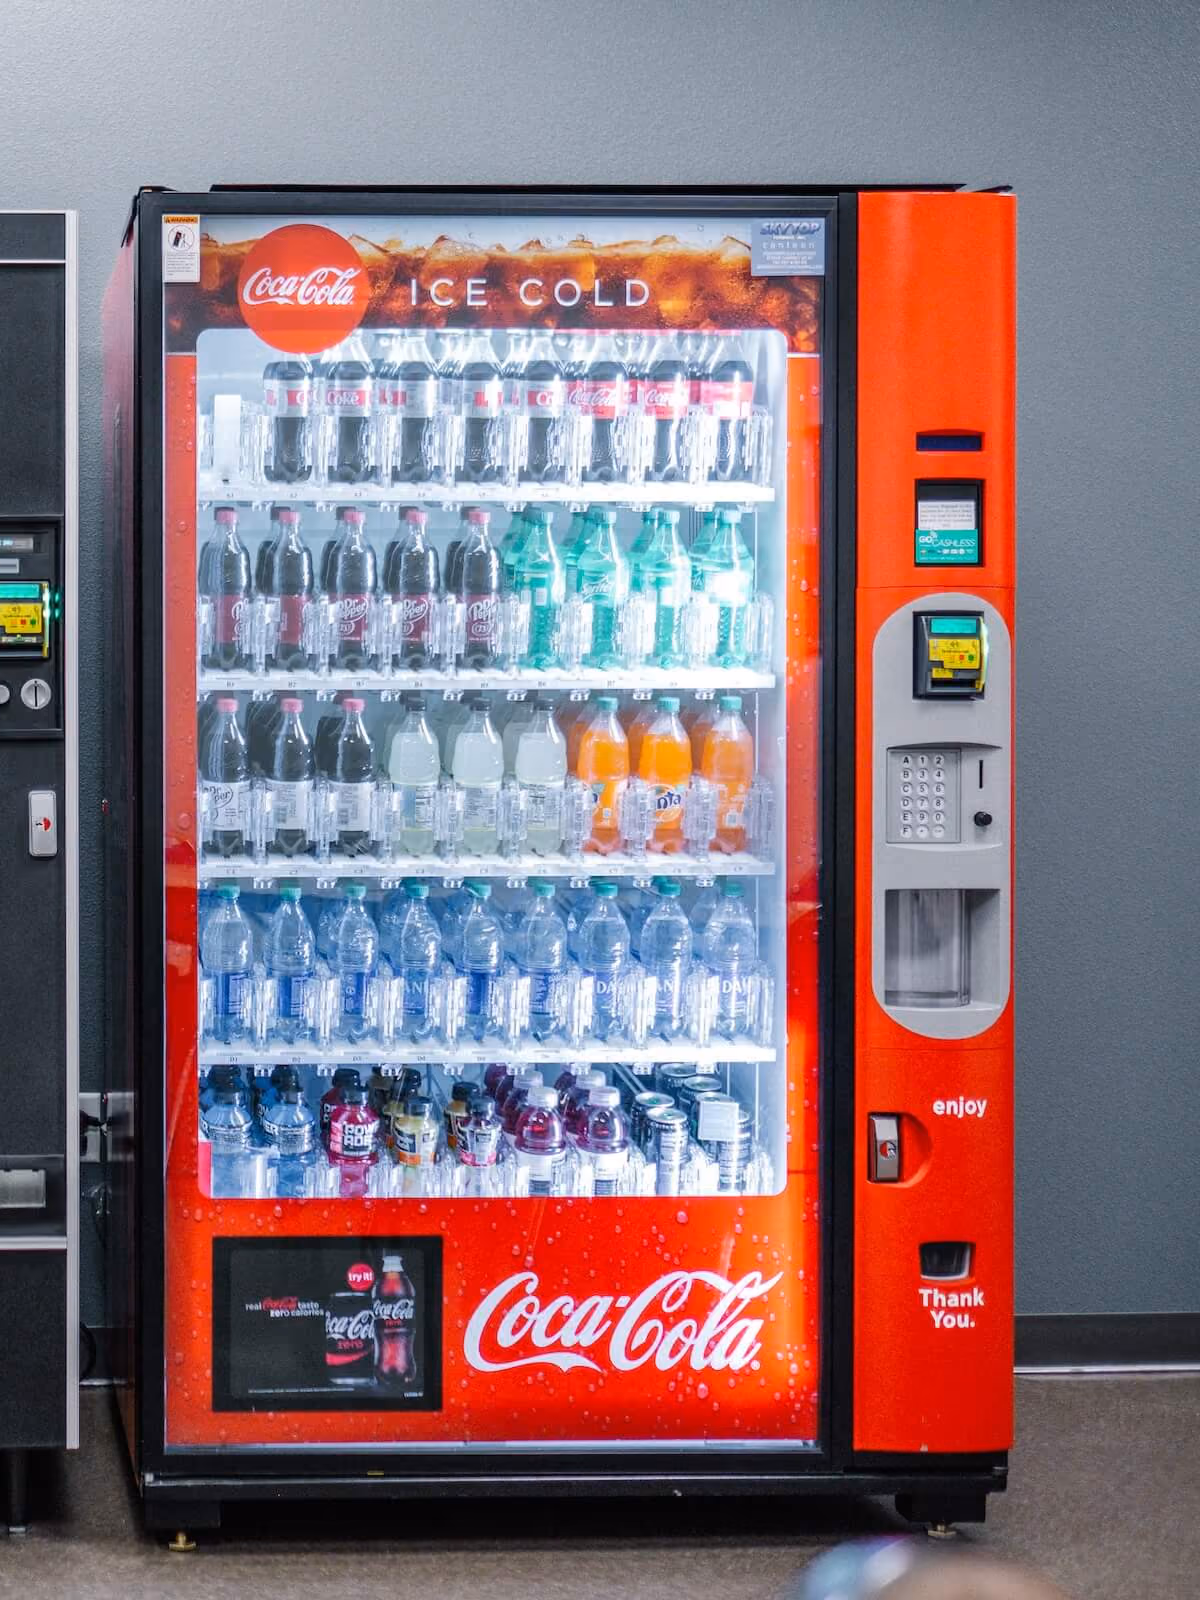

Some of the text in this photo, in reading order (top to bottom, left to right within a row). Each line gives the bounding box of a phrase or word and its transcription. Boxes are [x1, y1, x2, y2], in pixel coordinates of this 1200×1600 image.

[243, 264, 361, 305] Coca-Cola
[411, 278, 650, 307] ICE COLD
[656, 790, 682, 809] nta
[932, 1096, 988, 1118] enjoy
[348, 1271, 373, 1282] try it!
[245, 1302, 262, 1311] real
[298, 1301, 320, 1310] taste
[918, 1288, 985, 1308] Thank
[270, 1308, 324, 1318] zero calories
[463, 1271, 784, 1373] Coca-Cola
[930, 1310, 976, 1329] You.
